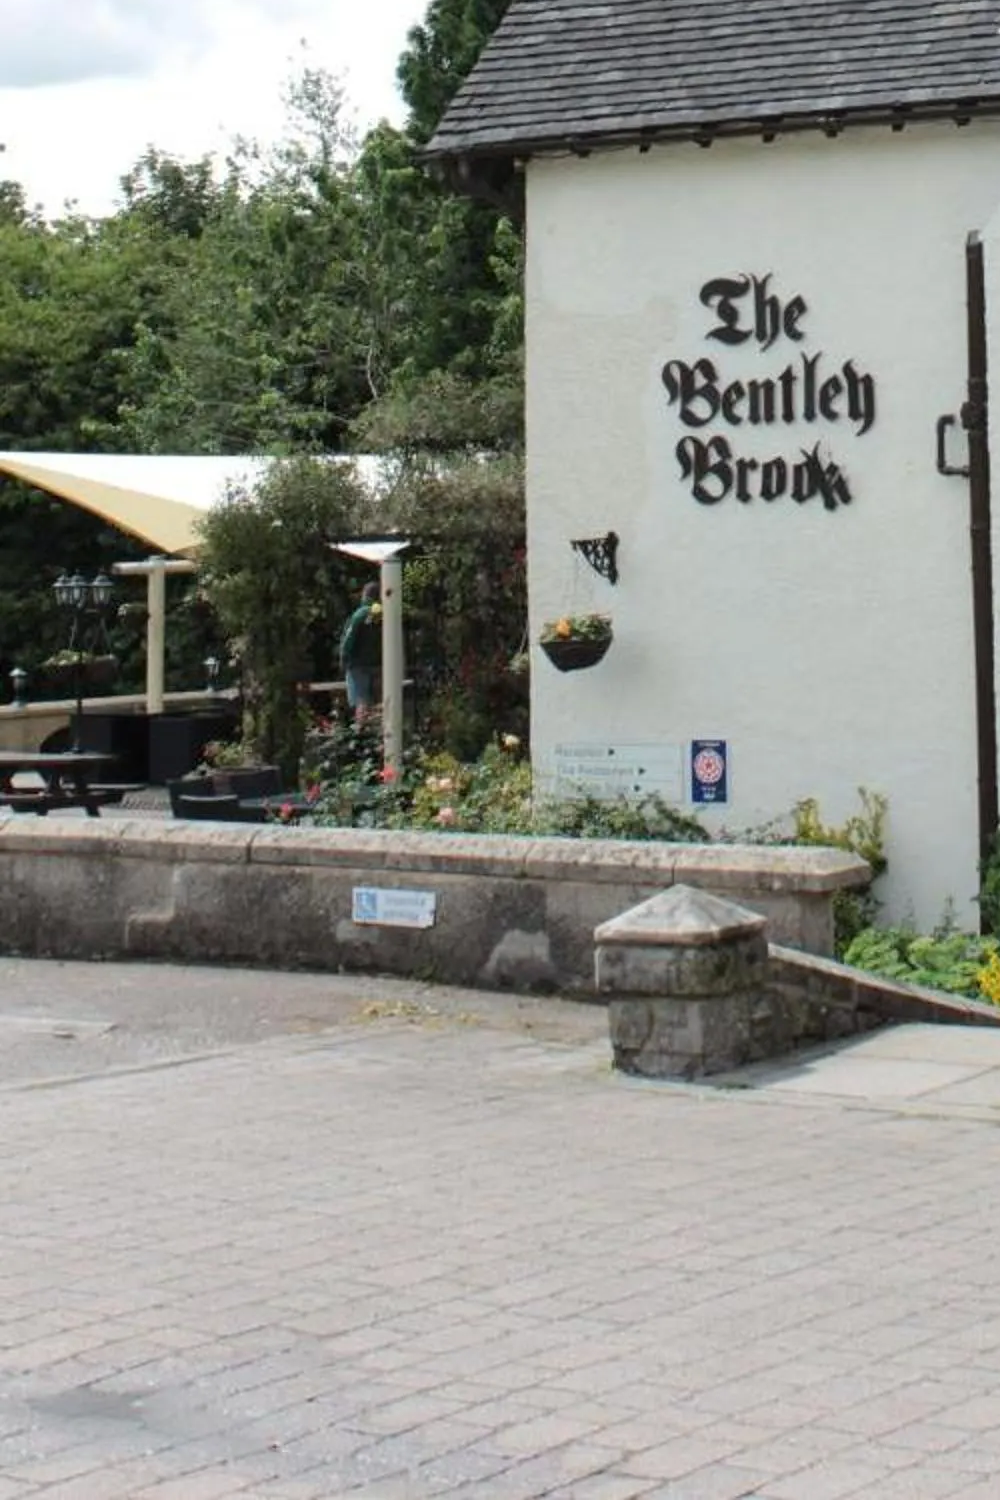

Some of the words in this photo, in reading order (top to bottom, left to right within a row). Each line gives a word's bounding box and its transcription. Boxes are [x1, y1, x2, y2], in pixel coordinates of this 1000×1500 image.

[699, 272, 808, 352] The
[661, 351, 876, 437] Bentley
[675, 436, 853, 512] Brook
